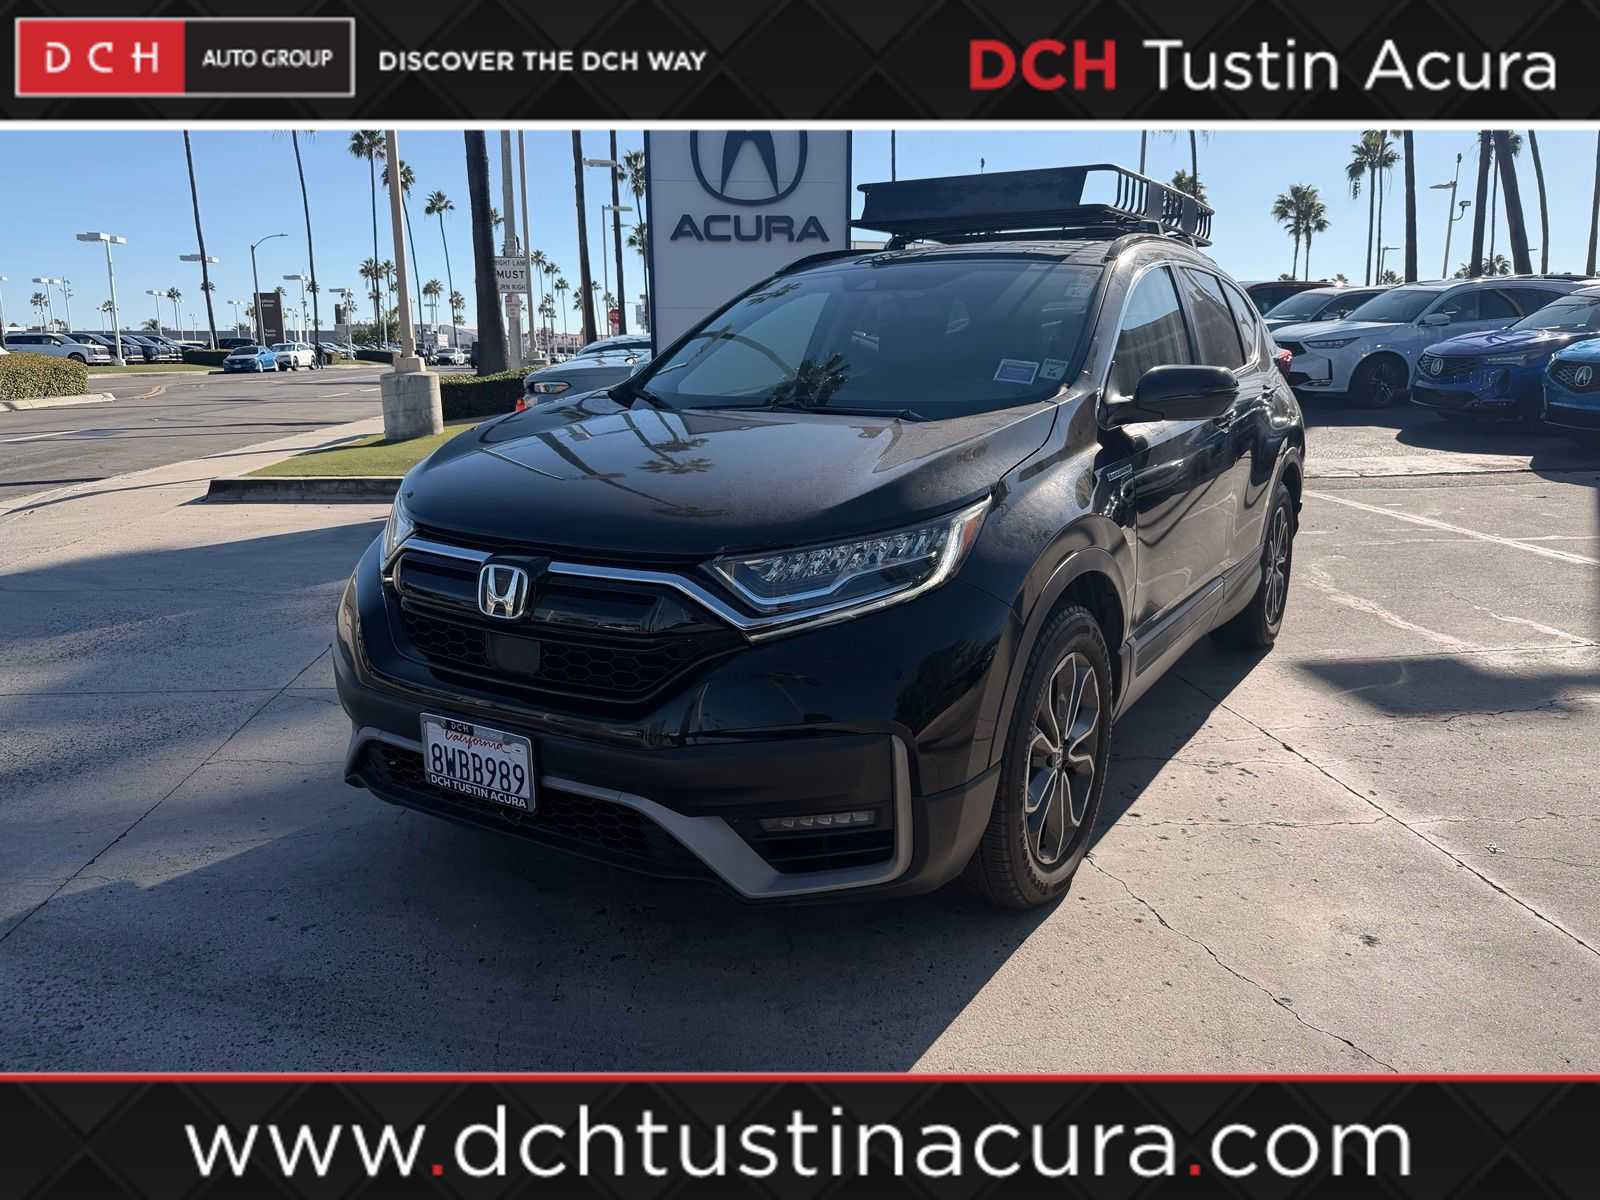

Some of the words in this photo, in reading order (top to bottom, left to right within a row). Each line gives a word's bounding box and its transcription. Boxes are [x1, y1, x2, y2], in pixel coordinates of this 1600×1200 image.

[669, 213, 830, 243] ACURA
[496, 270, 525, 279] MUST
[451, 722, 469, 734] DCH
[431, 743, 525, 795] 8WBB989
[431, 774, 451, 788] DCH
[452, 780, 489, 798] TUSTIN
[491, 791, 527, 808] ACURA
